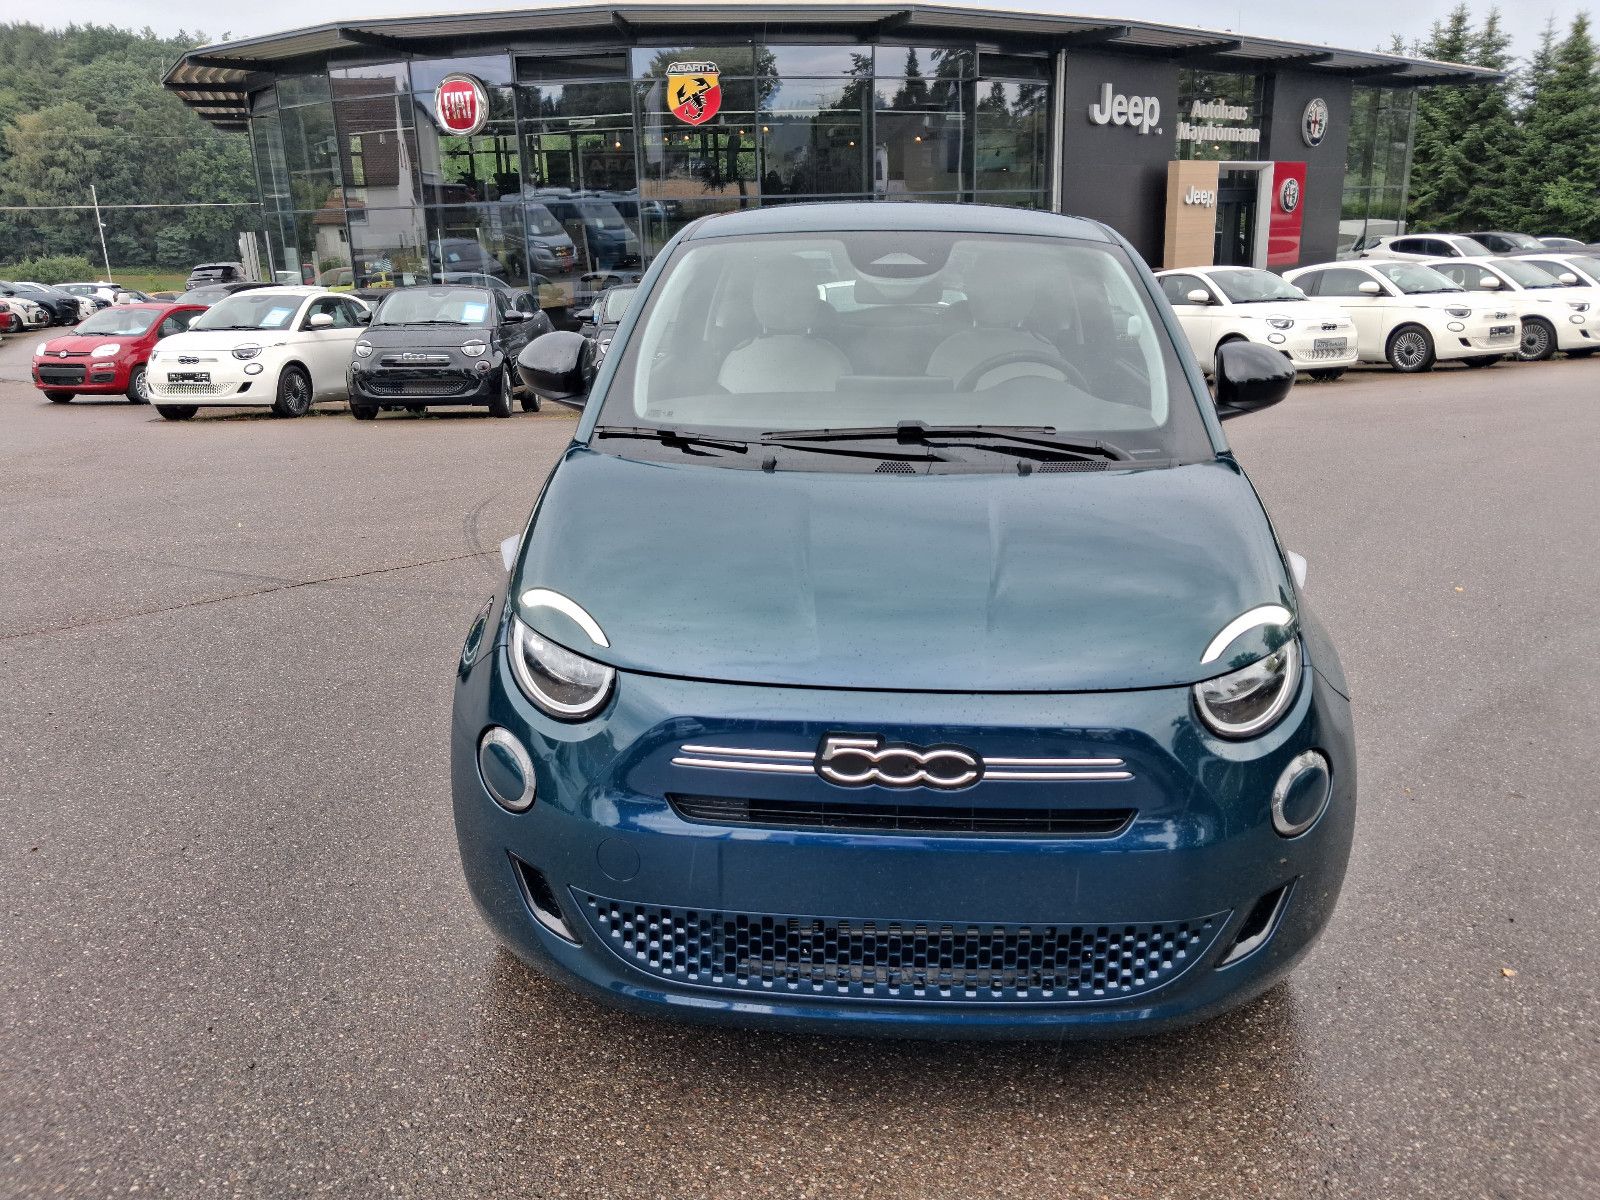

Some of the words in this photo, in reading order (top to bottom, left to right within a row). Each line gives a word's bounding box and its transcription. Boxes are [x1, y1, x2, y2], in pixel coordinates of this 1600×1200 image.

[669, 63, 716, 73] ABARTH
[443, 90, 473, 120] FIAT
[1089, 82, 1161, 135] Jeep
[1191, 99, 1249, 121] Autohaus
[1184, 184, 1215, 208] Jeep
[818, 734, 982, 788] 500
